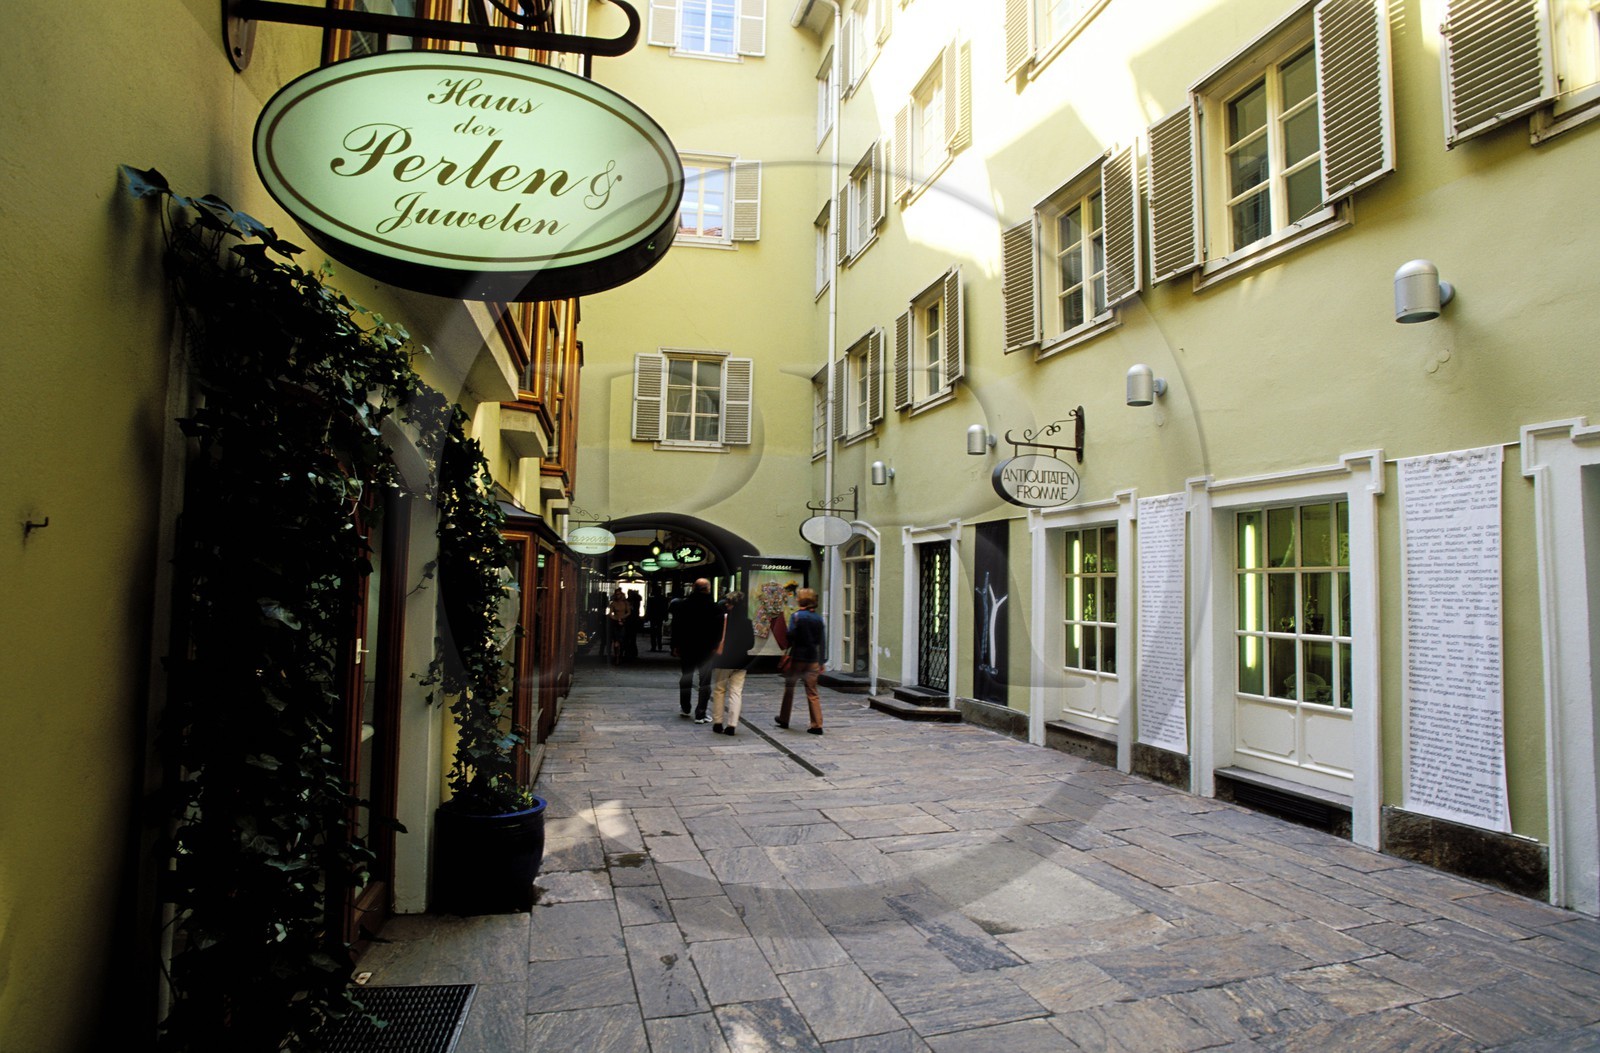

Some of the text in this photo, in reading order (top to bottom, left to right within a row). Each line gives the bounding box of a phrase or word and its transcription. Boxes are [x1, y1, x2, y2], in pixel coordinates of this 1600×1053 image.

[427, 77, 544, 115] Haus
[453, 115, 501, 137] der
[329, 122, 623, 210] Perlen &
[375, 191, 569, 236] Juwelen
[1016, 485, 1069, 501] FROMME
